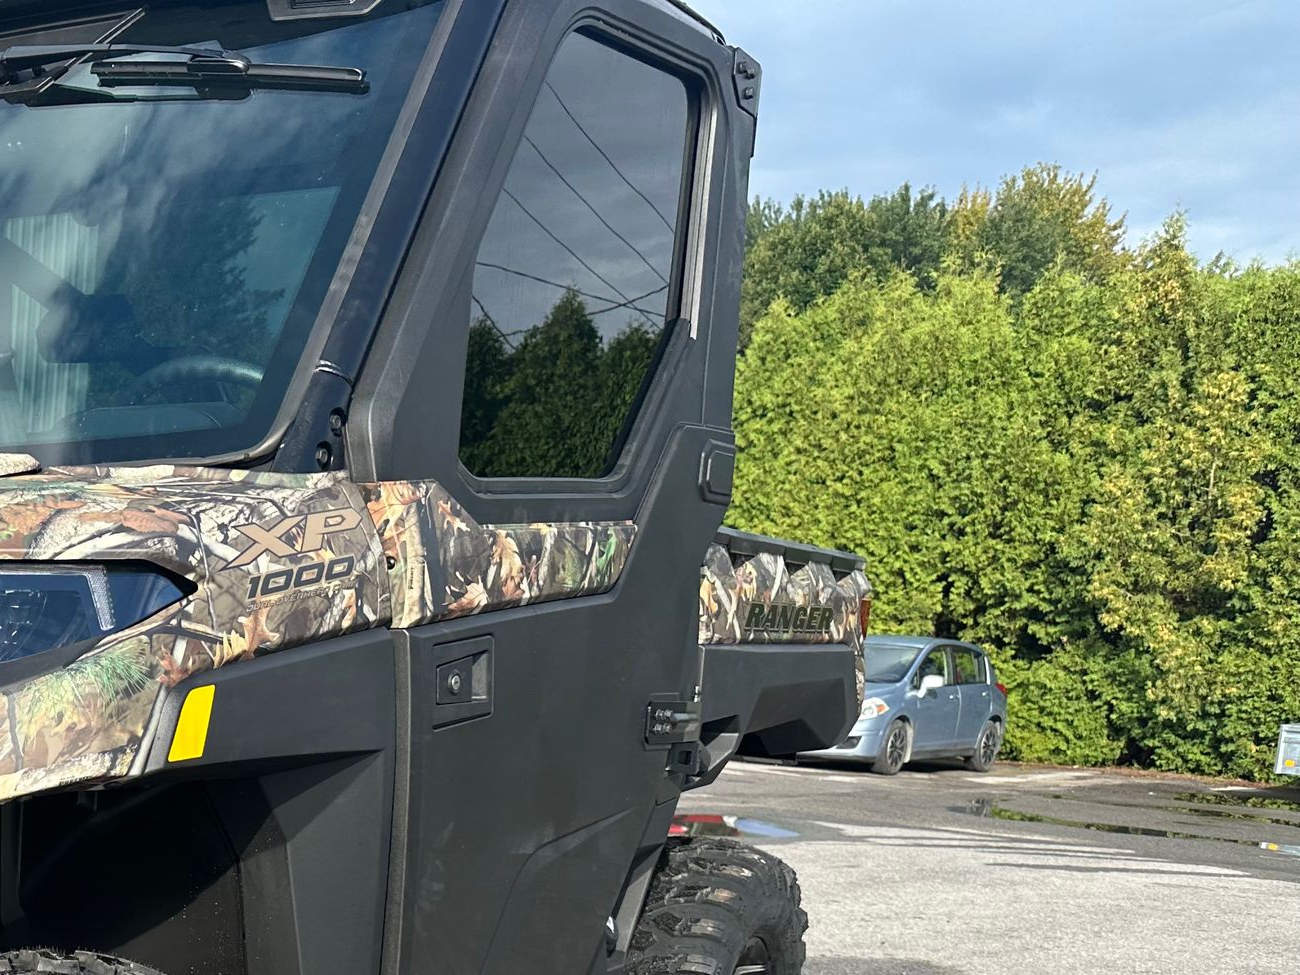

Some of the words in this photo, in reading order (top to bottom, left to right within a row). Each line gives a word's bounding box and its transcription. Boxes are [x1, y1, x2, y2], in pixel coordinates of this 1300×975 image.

[216, 506, 364, 572] XP
[246, 555, 356, 600] 1000
[743, 601, 834, 633] RANGER
